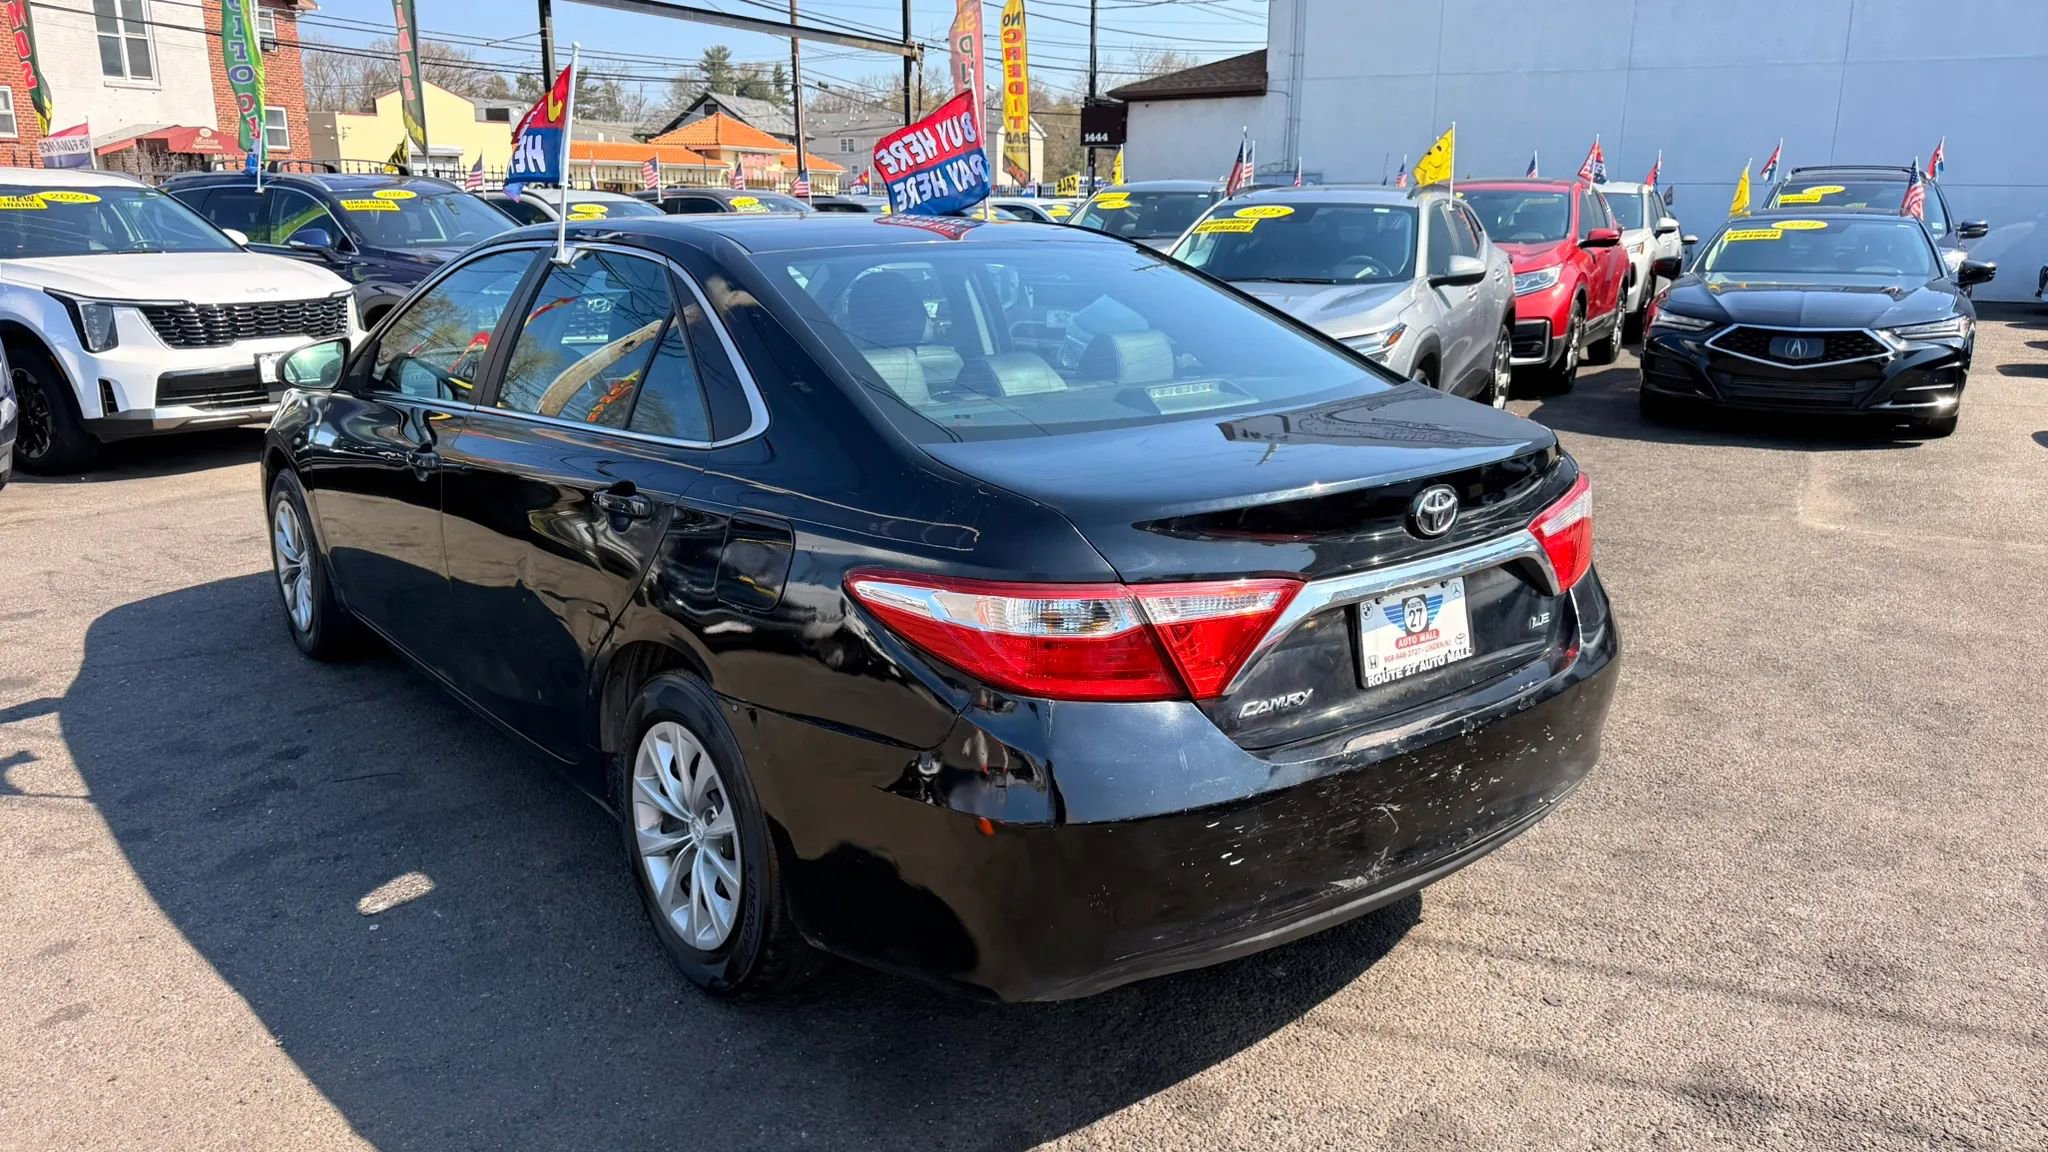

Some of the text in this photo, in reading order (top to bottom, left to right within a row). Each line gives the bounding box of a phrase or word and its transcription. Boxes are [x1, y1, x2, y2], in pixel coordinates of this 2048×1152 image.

[1084, 132, 1109, 142] 1444
[1408, 607, 1423, 628] 27
[1398, 630, 1438, 648] AUTO MALL
[1367, 647, 1473, 687] ROUTE 27 AUTO MALL
[1238, 688, 1314, 719] CAMRY
